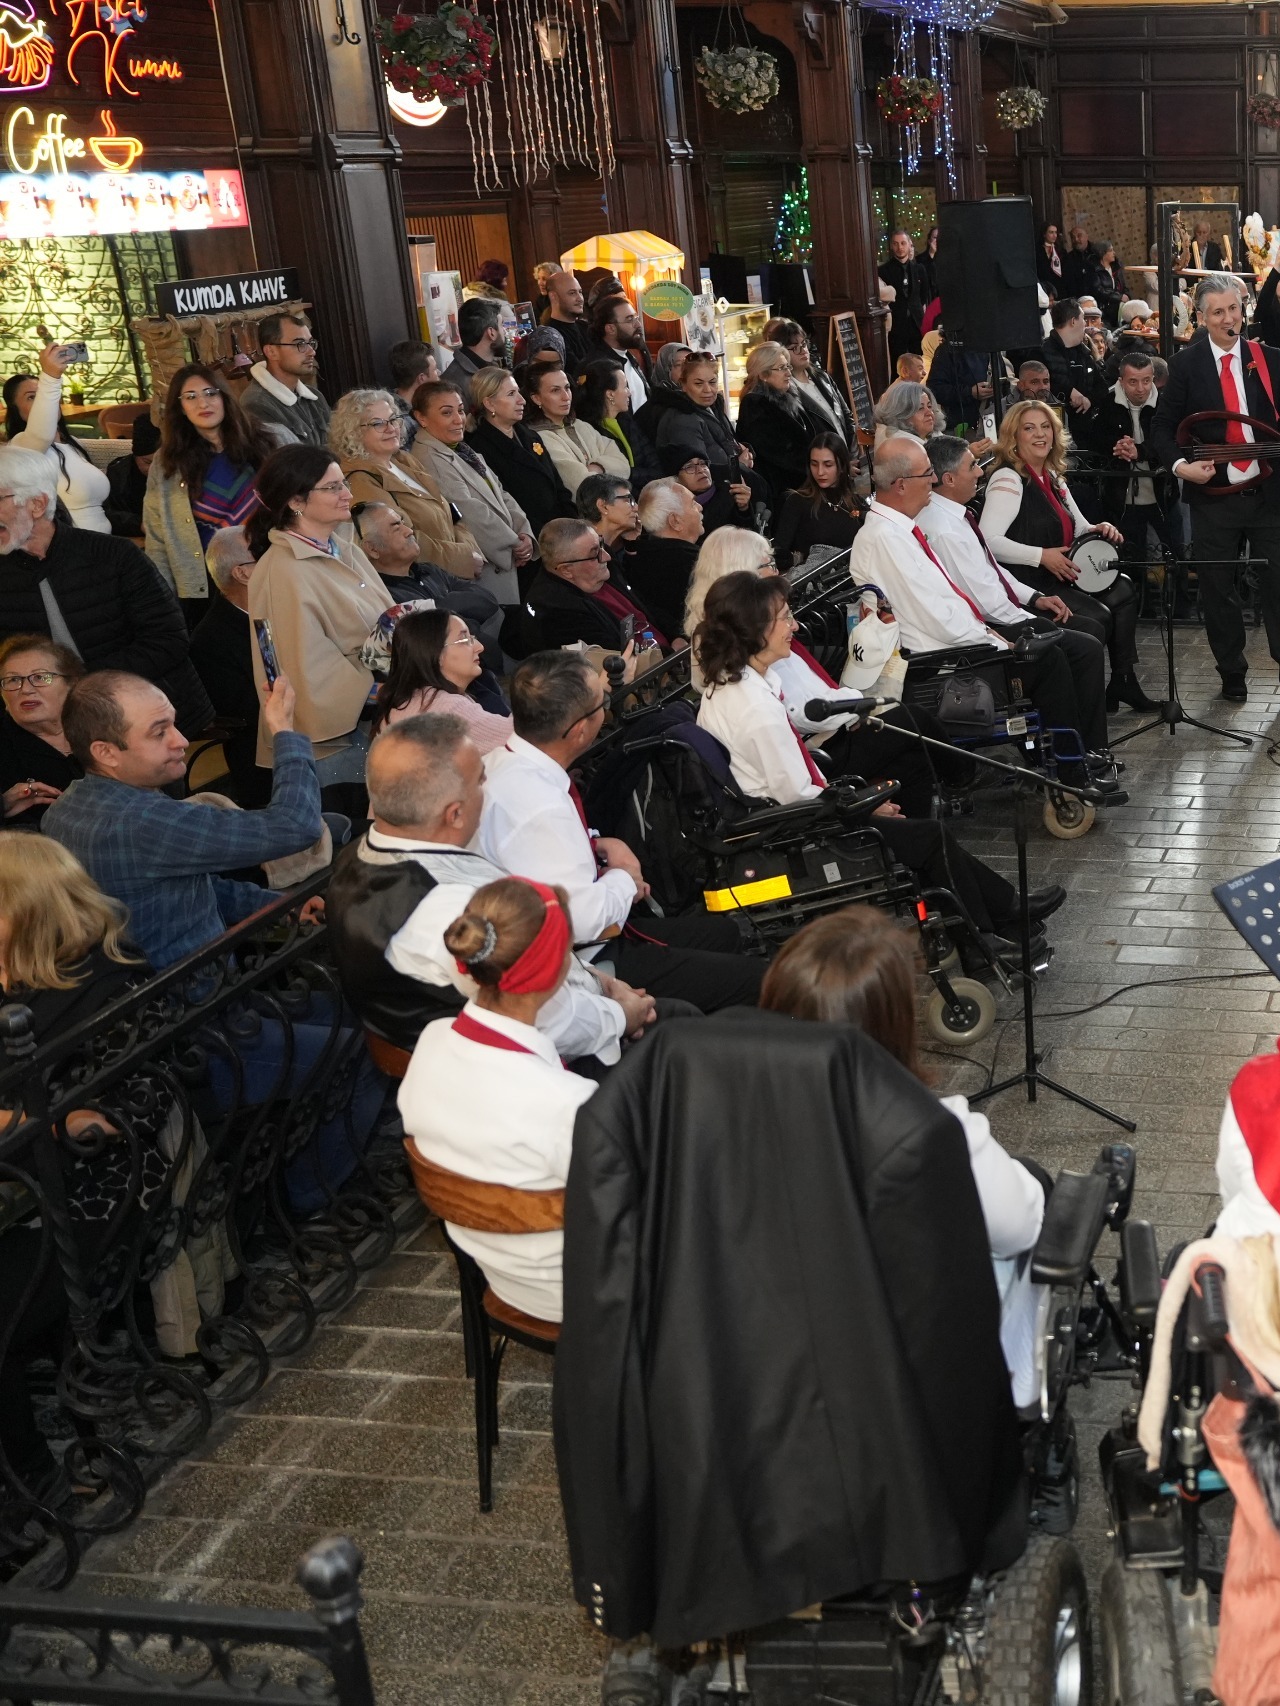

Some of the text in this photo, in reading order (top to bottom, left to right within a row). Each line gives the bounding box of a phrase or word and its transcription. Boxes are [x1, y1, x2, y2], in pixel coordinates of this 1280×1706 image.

[8, 106, 86, 176] Coffee
[174, 276, 288, 313] KUMDA KAHVE
